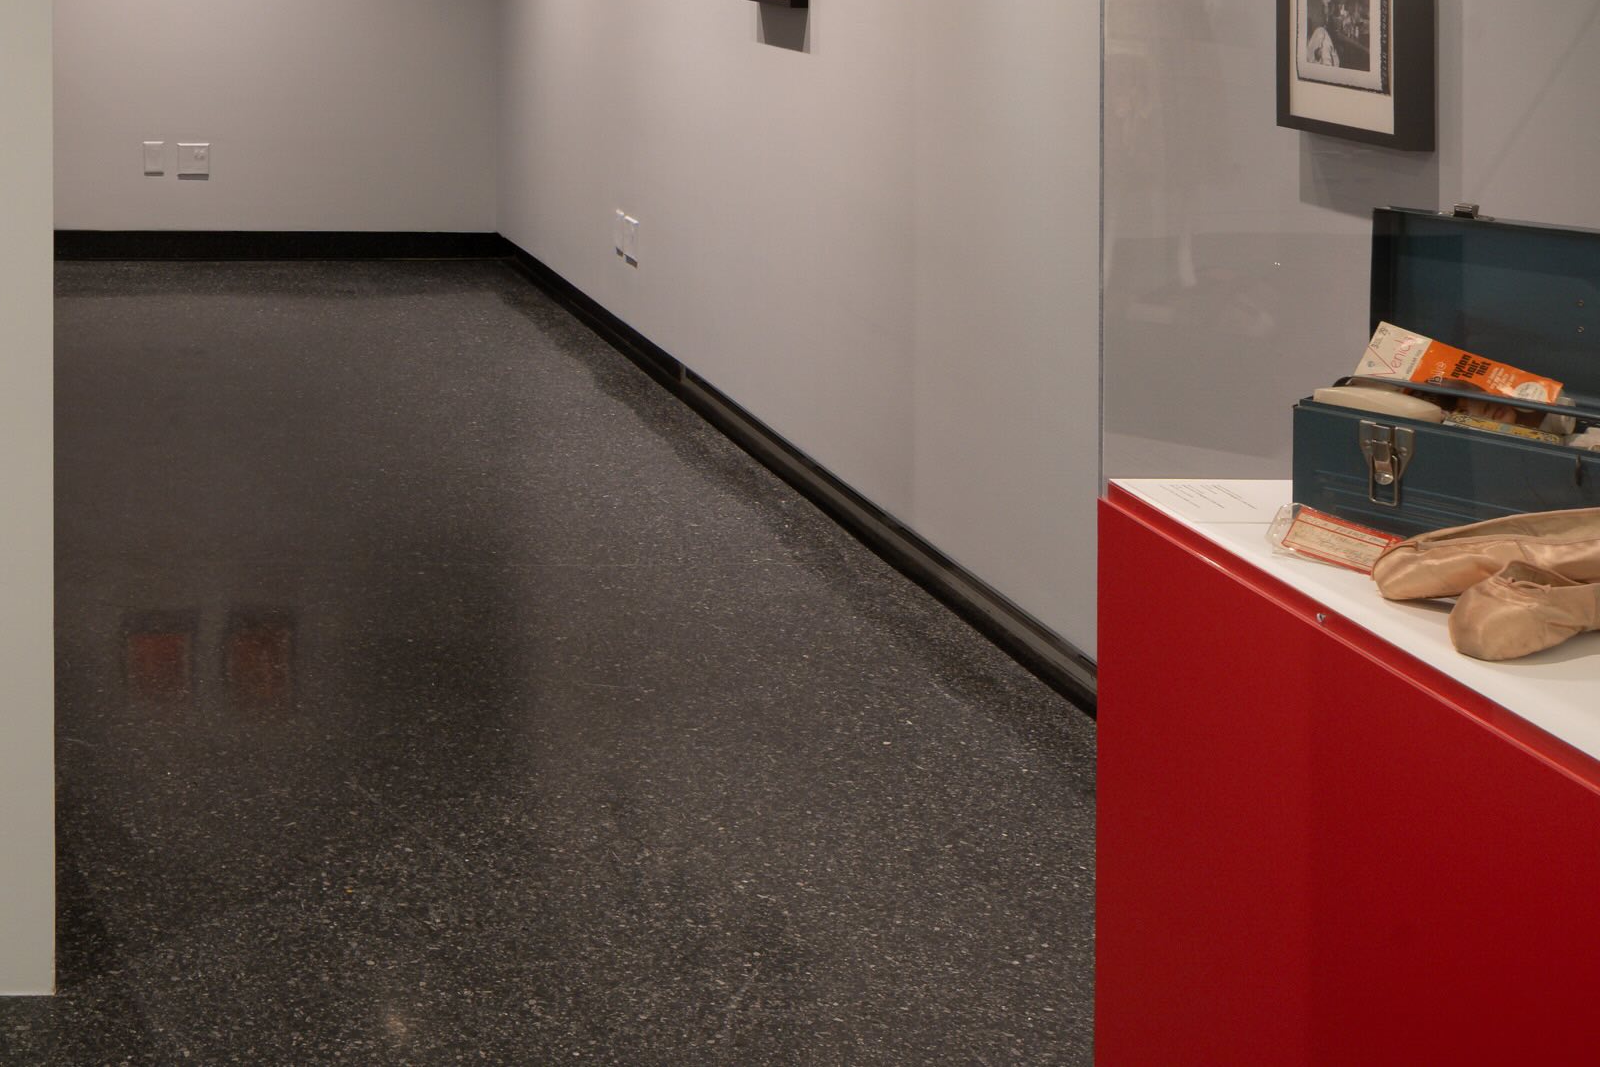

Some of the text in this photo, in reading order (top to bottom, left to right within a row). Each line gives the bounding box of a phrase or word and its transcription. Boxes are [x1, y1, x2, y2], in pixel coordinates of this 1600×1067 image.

[1451, 353, 1473, 379] nylon
[1462, 359, 1481, 379] hair
[1475, 361, 1492, 376] net
